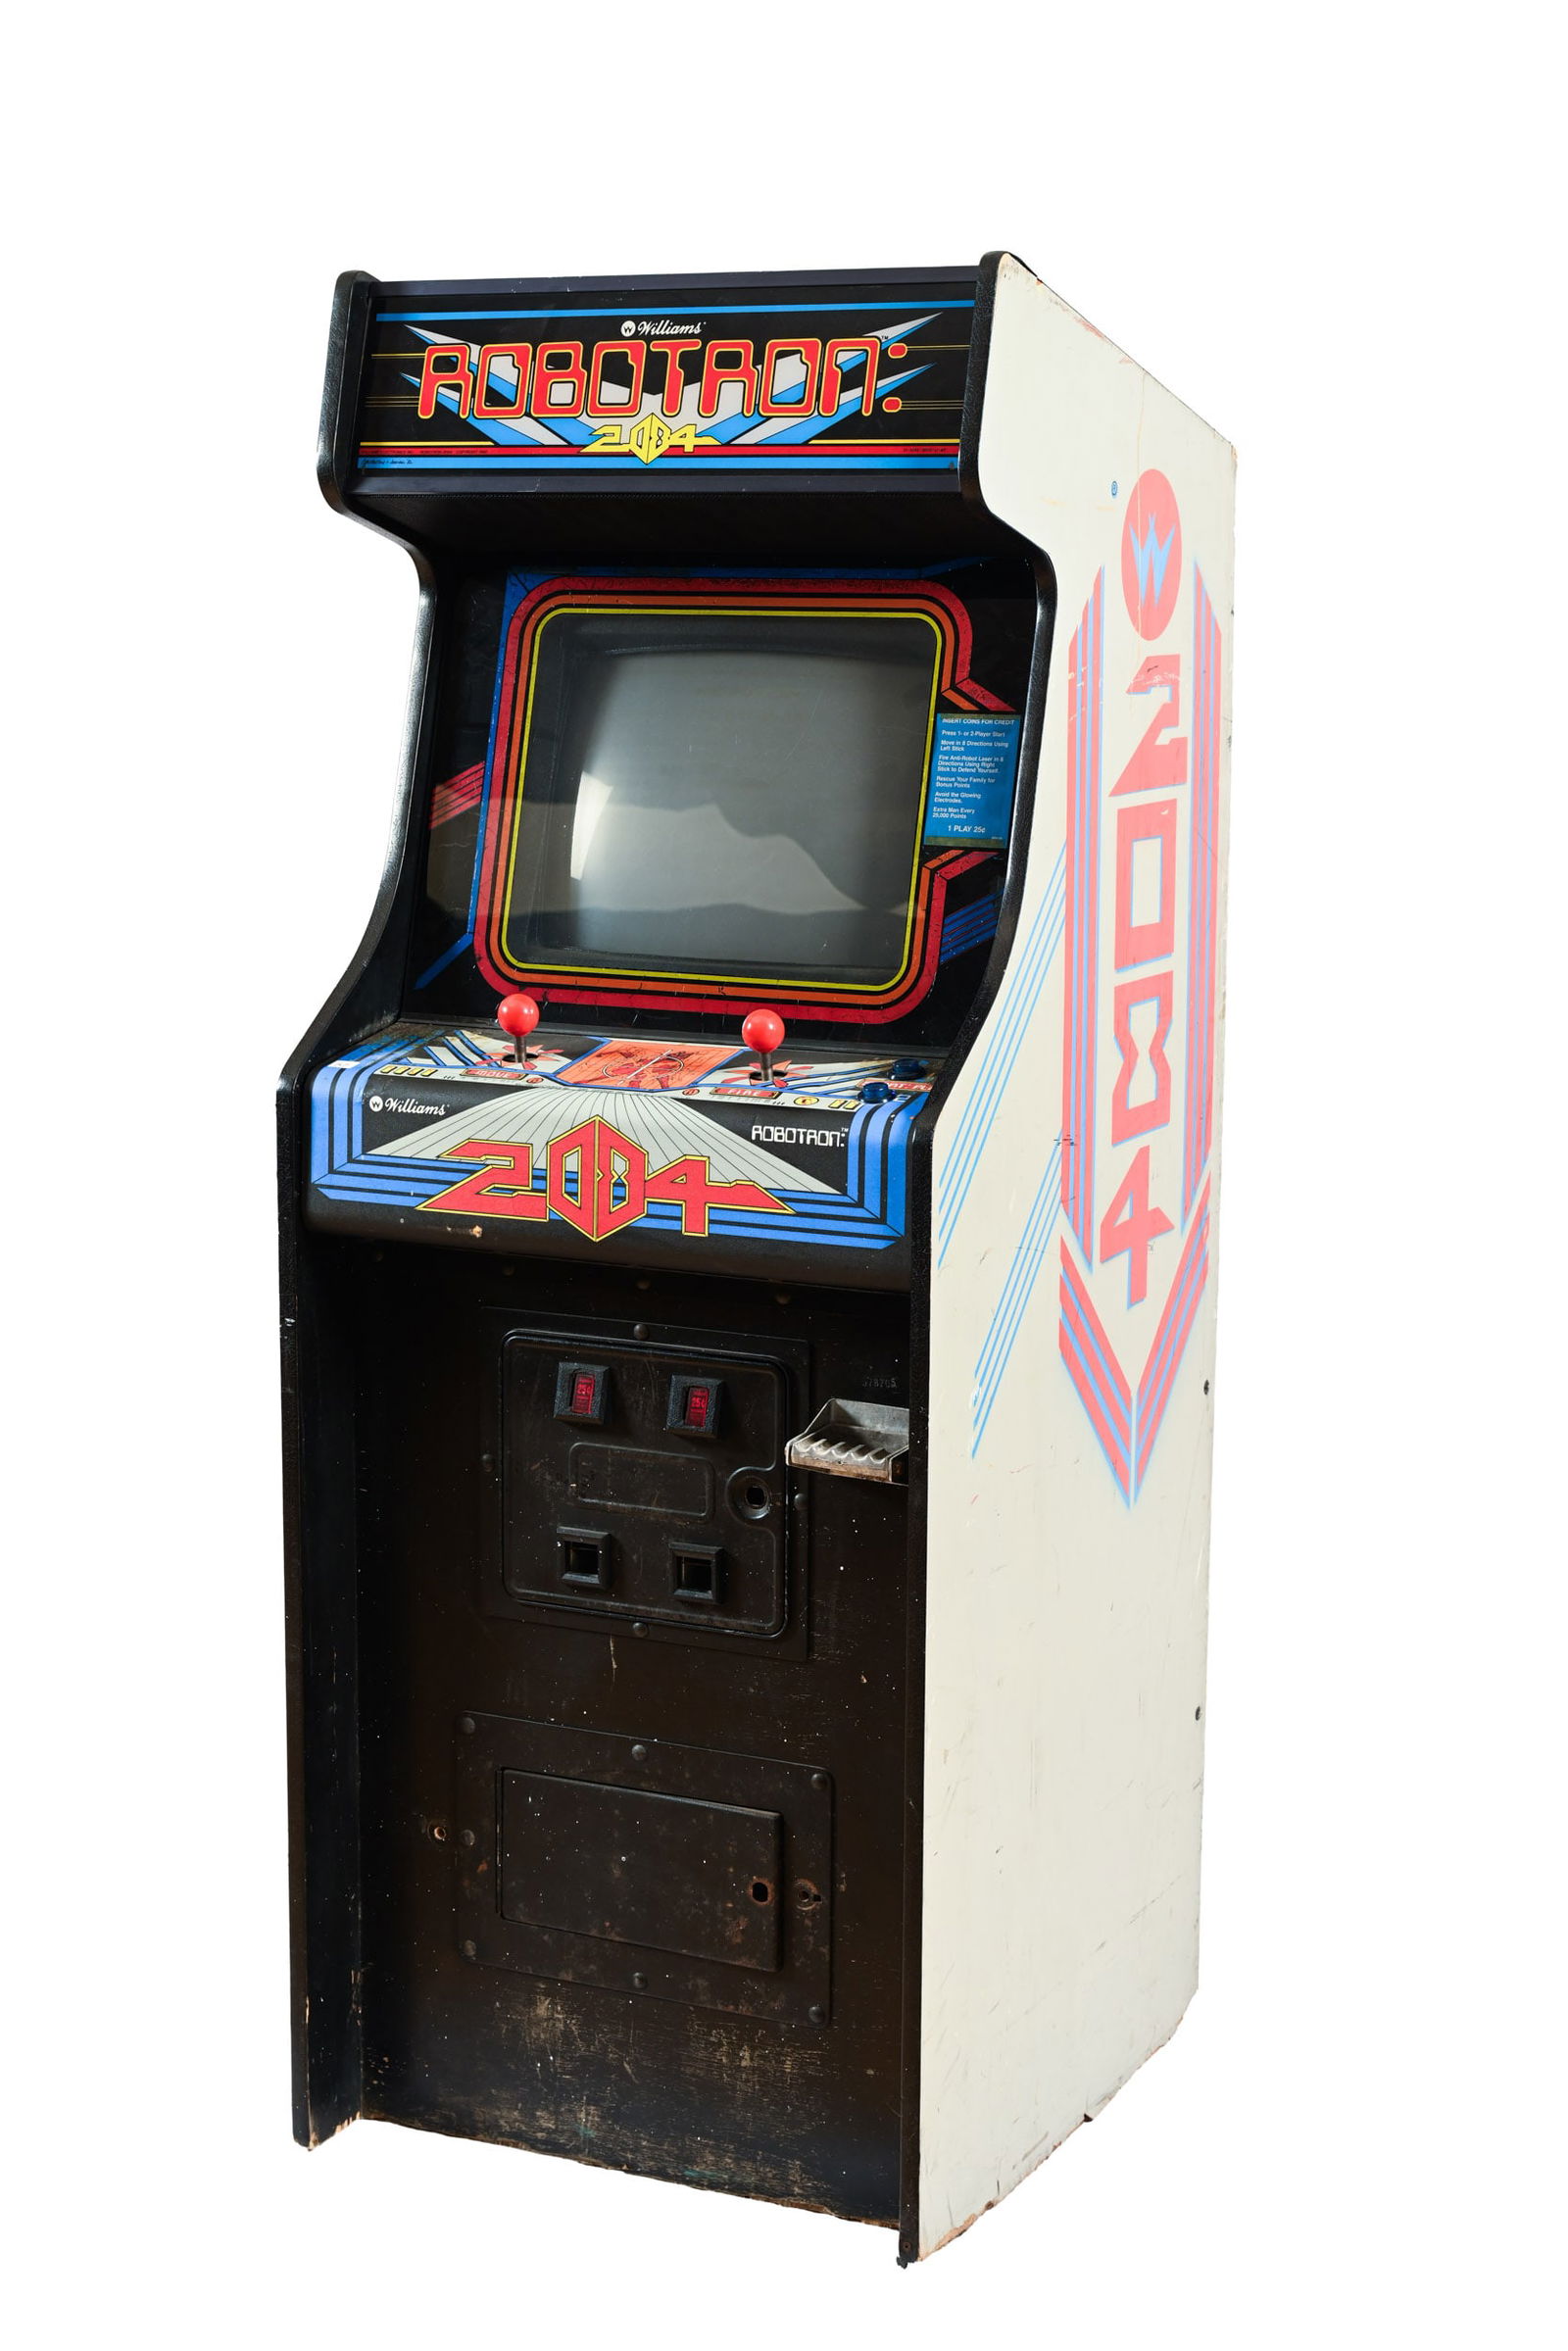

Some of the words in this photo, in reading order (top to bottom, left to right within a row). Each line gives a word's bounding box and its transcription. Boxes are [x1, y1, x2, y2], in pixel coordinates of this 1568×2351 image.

[637, 319, 703, 336] Williams
[578, 413, 722, 465] 2084
[384, 1097, 447, 1116] Williams
[416, 1115, 797, 1243] 2084
